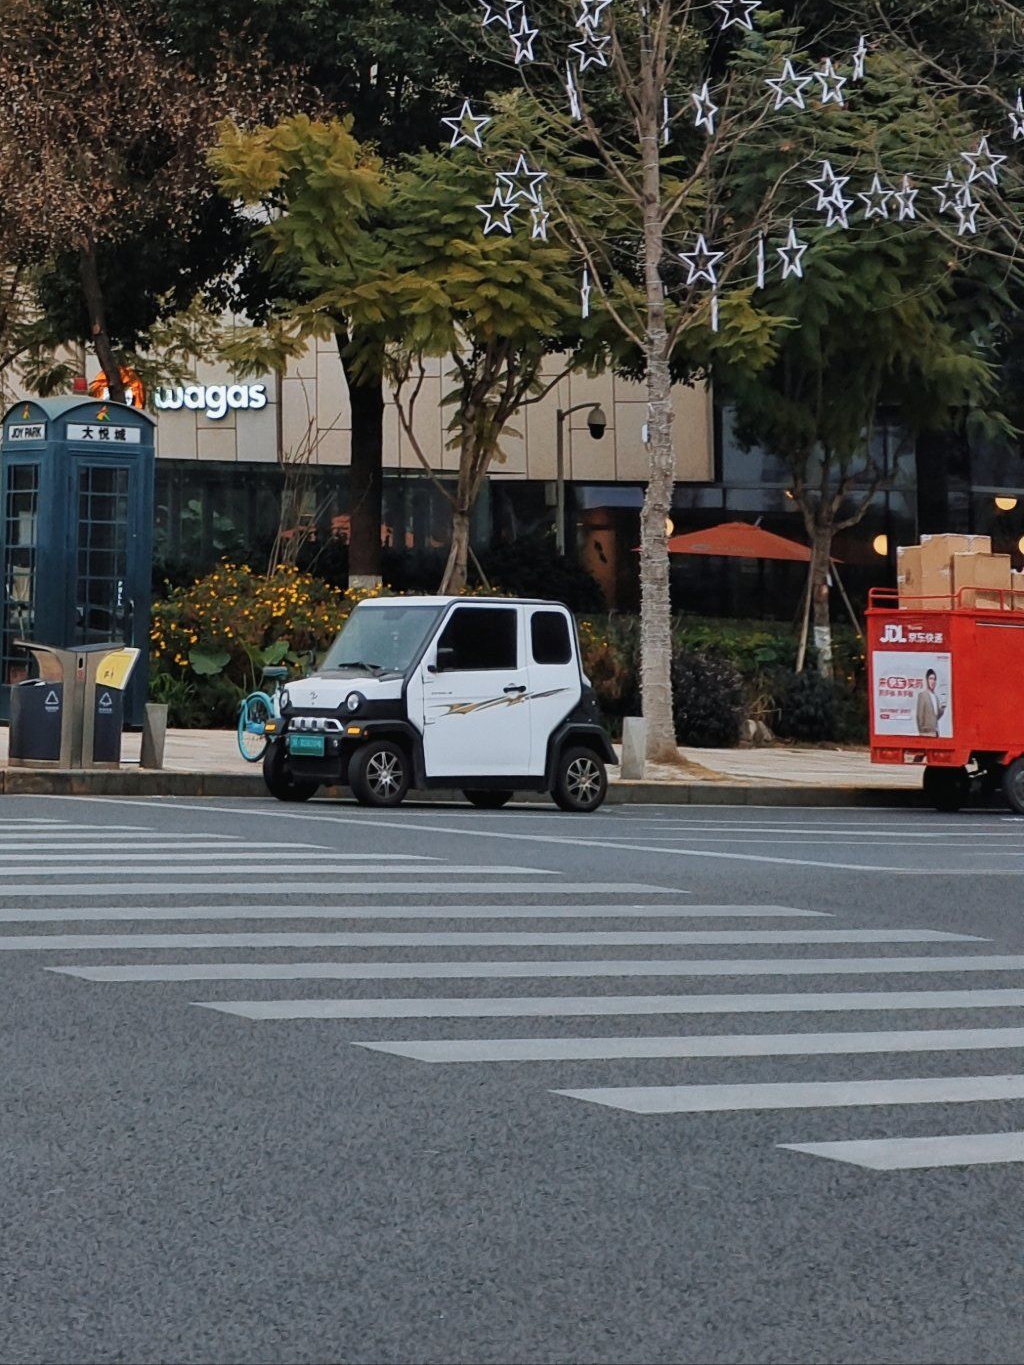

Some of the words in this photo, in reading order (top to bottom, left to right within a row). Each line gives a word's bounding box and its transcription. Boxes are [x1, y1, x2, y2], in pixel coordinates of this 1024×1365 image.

[155, 383, 267, 419] wagas
[10, 427, 24, 439] JOY
[24, 426, 42, 438] PARK
[81, 425, 127, 442] 大悦城
[879, 624, 908, 643] JDL
